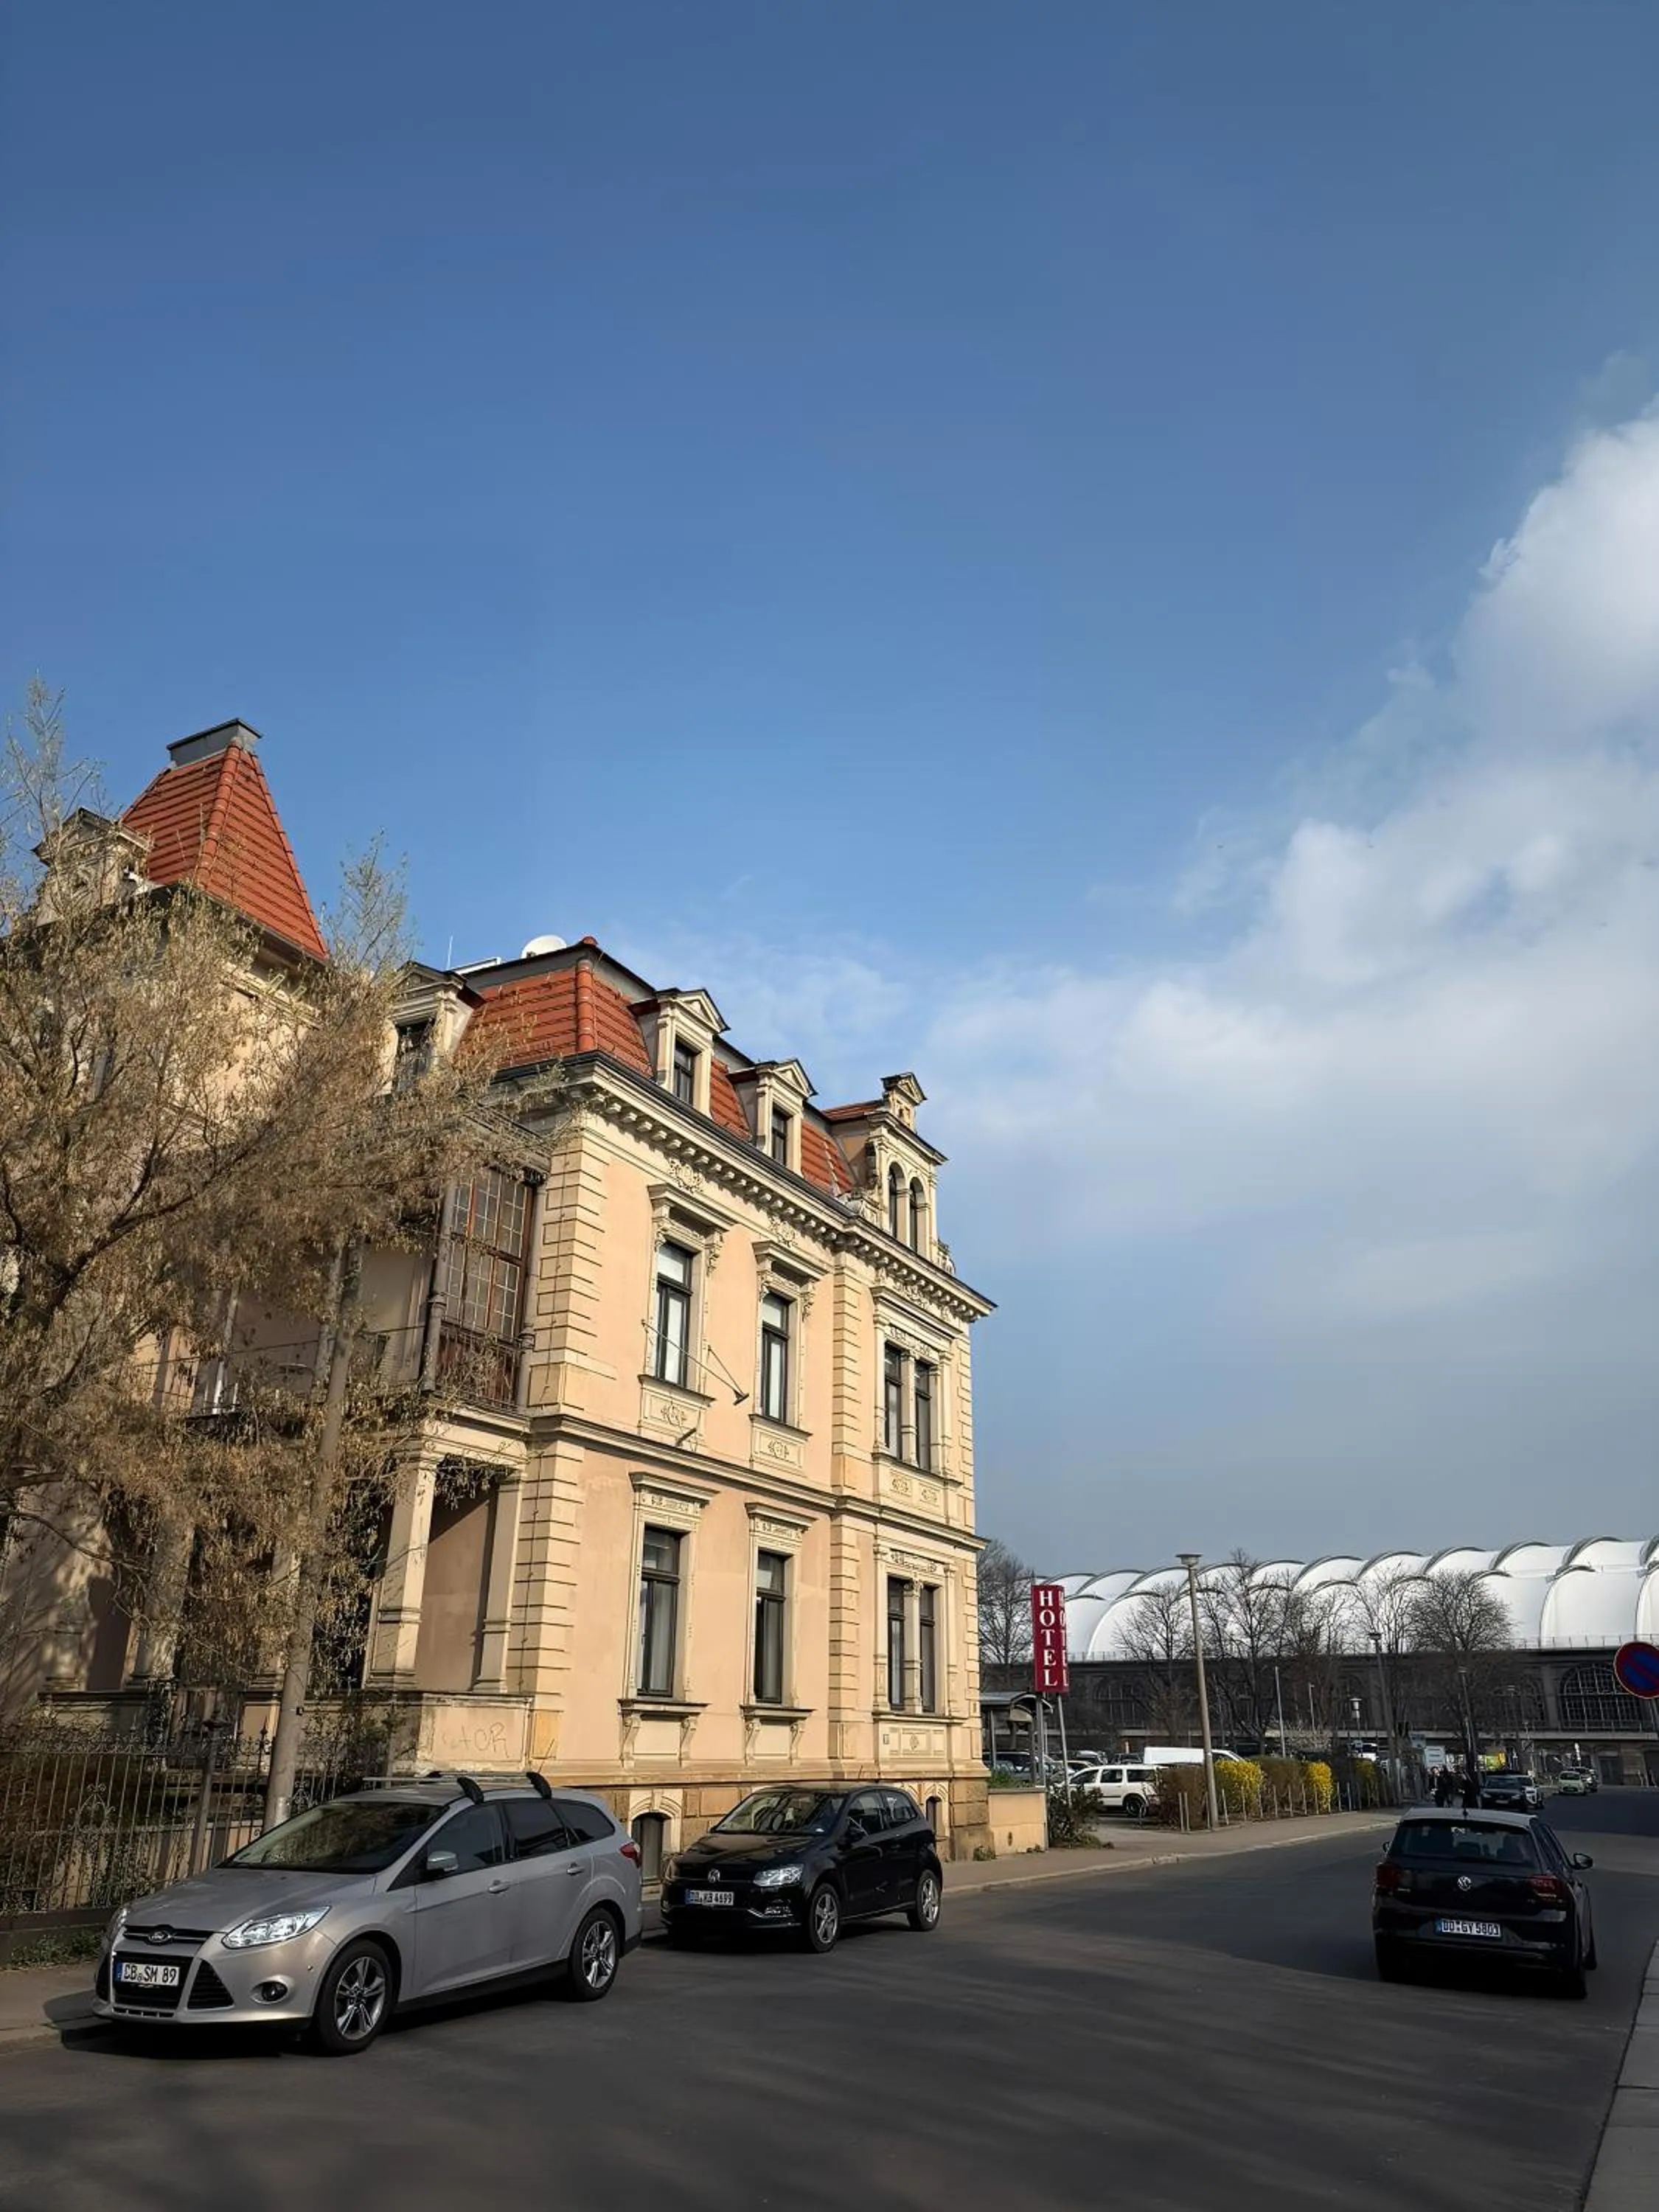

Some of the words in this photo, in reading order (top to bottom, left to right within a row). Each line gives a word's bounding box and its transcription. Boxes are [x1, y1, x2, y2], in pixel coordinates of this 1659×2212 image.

[1039, 1590, 1058, 1686] HOTEL
[124, 1964, 137, 1980] CB
[143, 1965, 159, 1983] SM
[162, 1966, 177, 1983] 89
